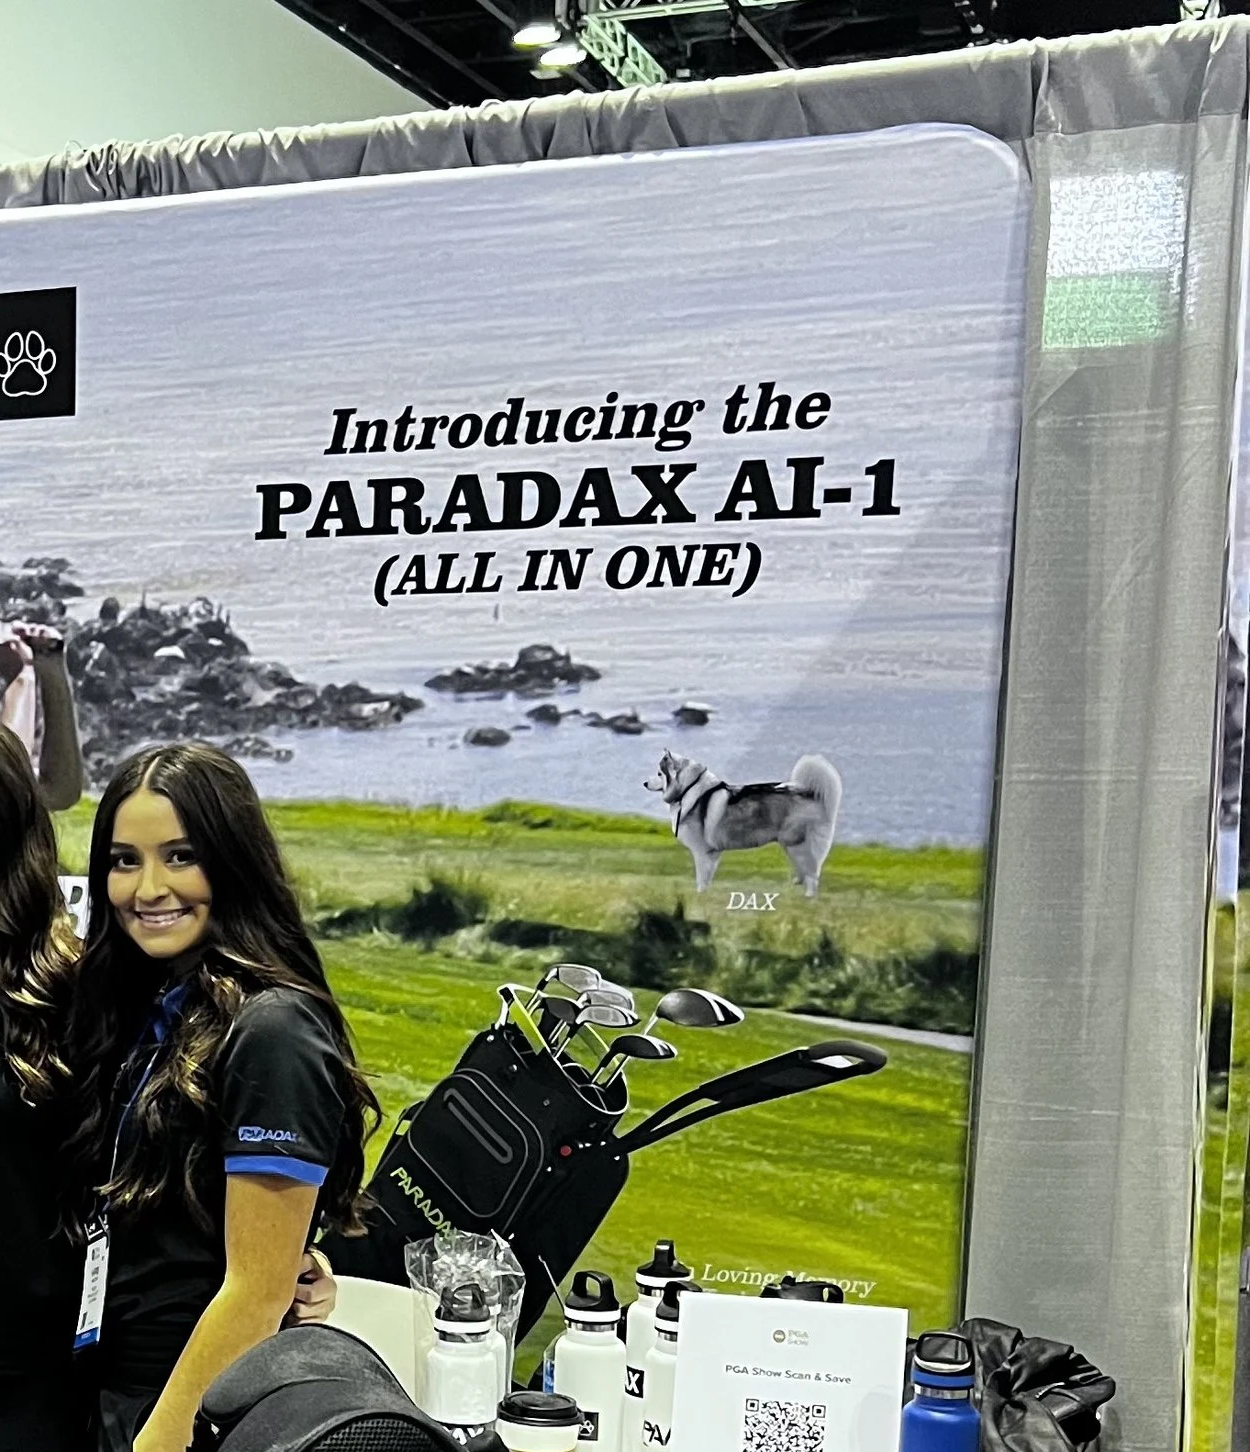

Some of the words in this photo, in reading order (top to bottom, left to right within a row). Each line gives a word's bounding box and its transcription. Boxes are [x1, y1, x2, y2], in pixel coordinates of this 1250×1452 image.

[323, 392, 706, 455] Introducing
[722, 382, 833, 434] the
[254, 463, 698, 541] PARADAX
[716, 458, 902, 522] AI-1
[373, 552, 502, 607] (ALL
[518, 548, 593, 592] IN
[605, 541, 764, 597] ONE)
[726, 892, 780, 911] DAX
[390, 1166, 452, 1240] PARADA
[702, 1263, 780, 1289] Loving
[725, 1364, 749, 1375] PGA
[752, 1367, 782, 1378] Show
[785, 1370, 811, 1381] Scan
[814, 1372, 822, 1381] &
[824, 1373, 852, 1385] Save
